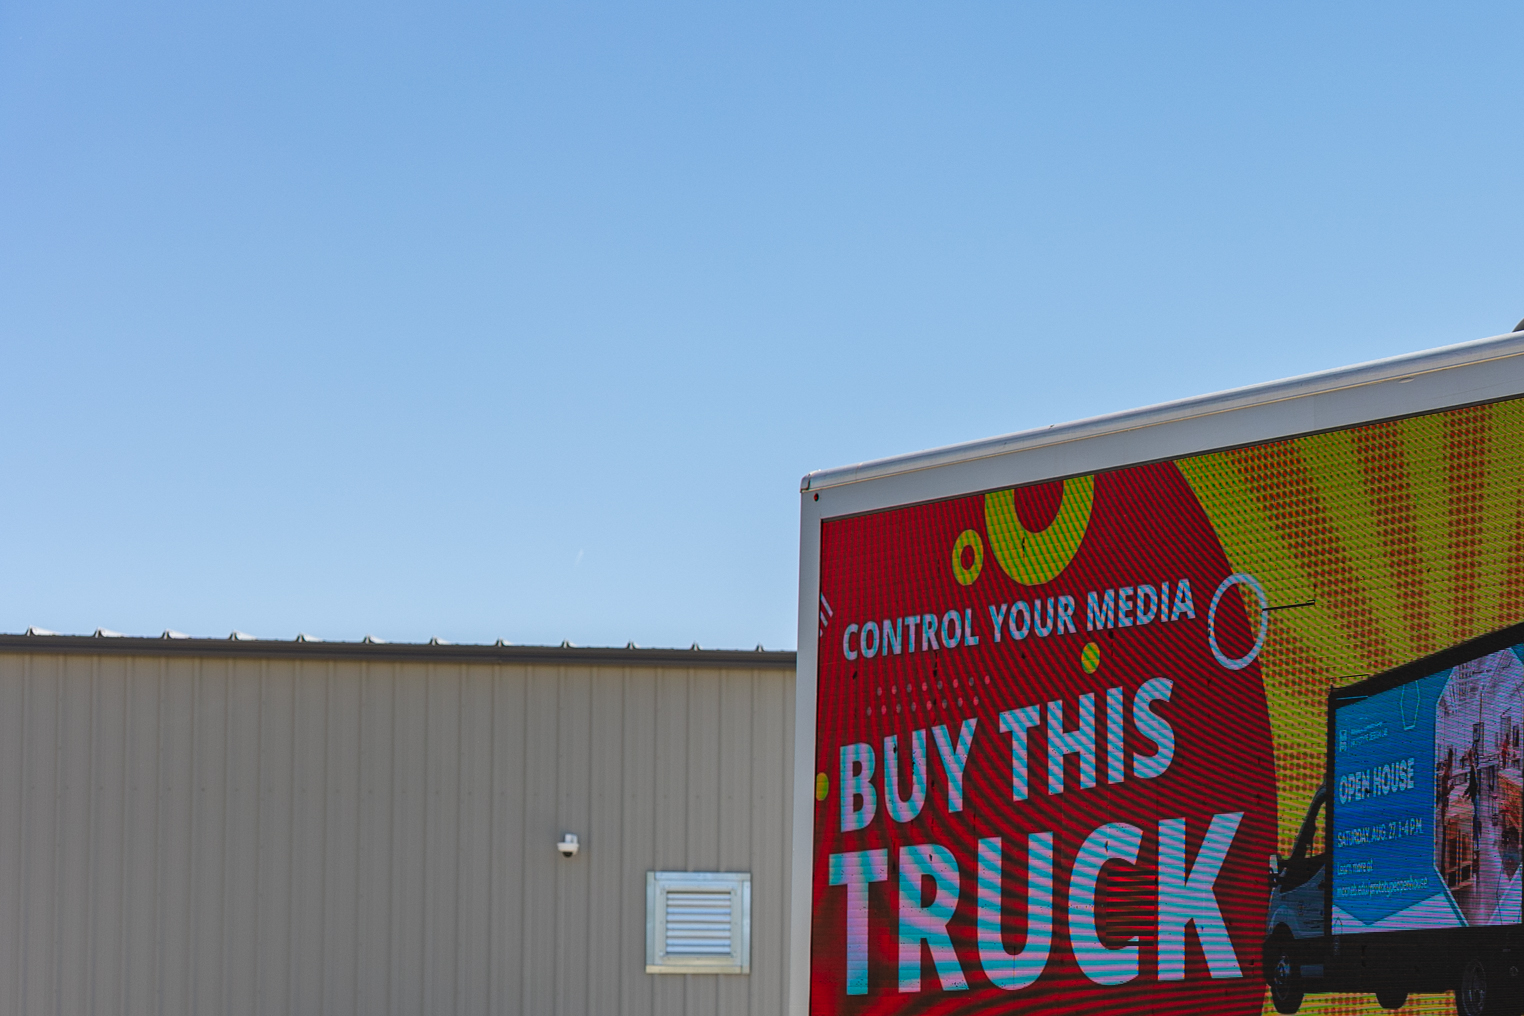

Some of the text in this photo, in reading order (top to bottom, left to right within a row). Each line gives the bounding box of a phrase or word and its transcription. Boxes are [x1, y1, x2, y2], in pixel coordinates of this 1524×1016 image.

[843, 578, 1196, 661] CONTROL YOUR MEDIA
[840, 677, 1176, 833] BUY THIS
[1339, 758, 1415, 804] OPEN HOUSE
[828, 811, 1245, 996] TRUCK
